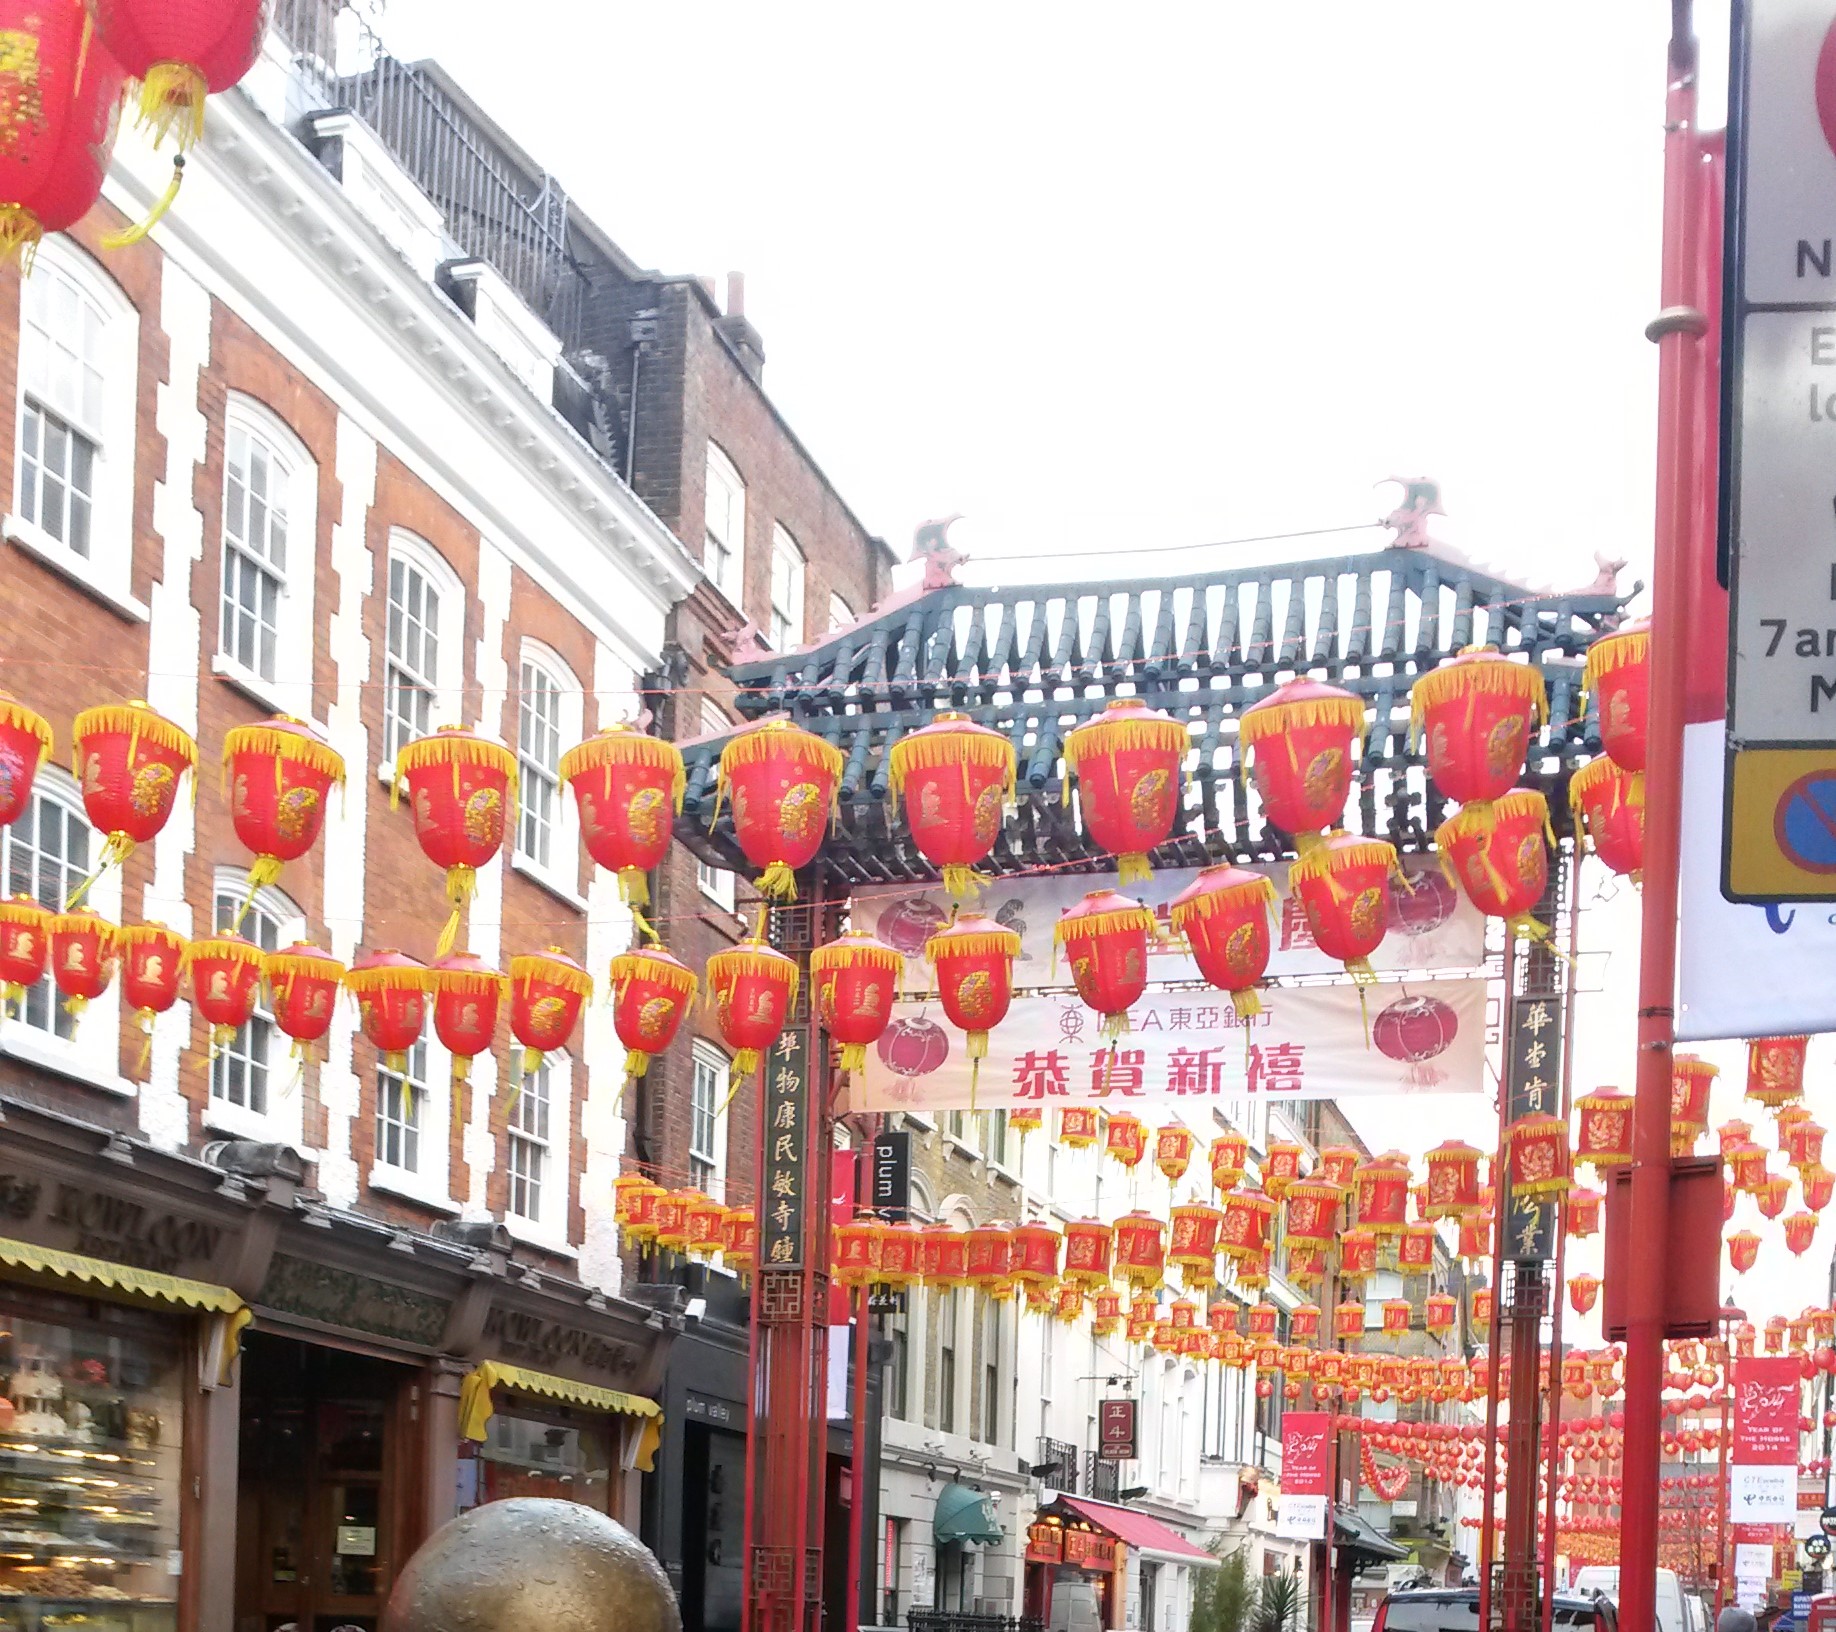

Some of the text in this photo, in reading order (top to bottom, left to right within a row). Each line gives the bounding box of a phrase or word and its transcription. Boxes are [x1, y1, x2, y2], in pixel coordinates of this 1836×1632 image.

[1012, 1041, 1305, 1099] 恭賀新禧
[876, 1145, 898, 1198] plum
[1759, 1435, 1791, 1443] HORSE
